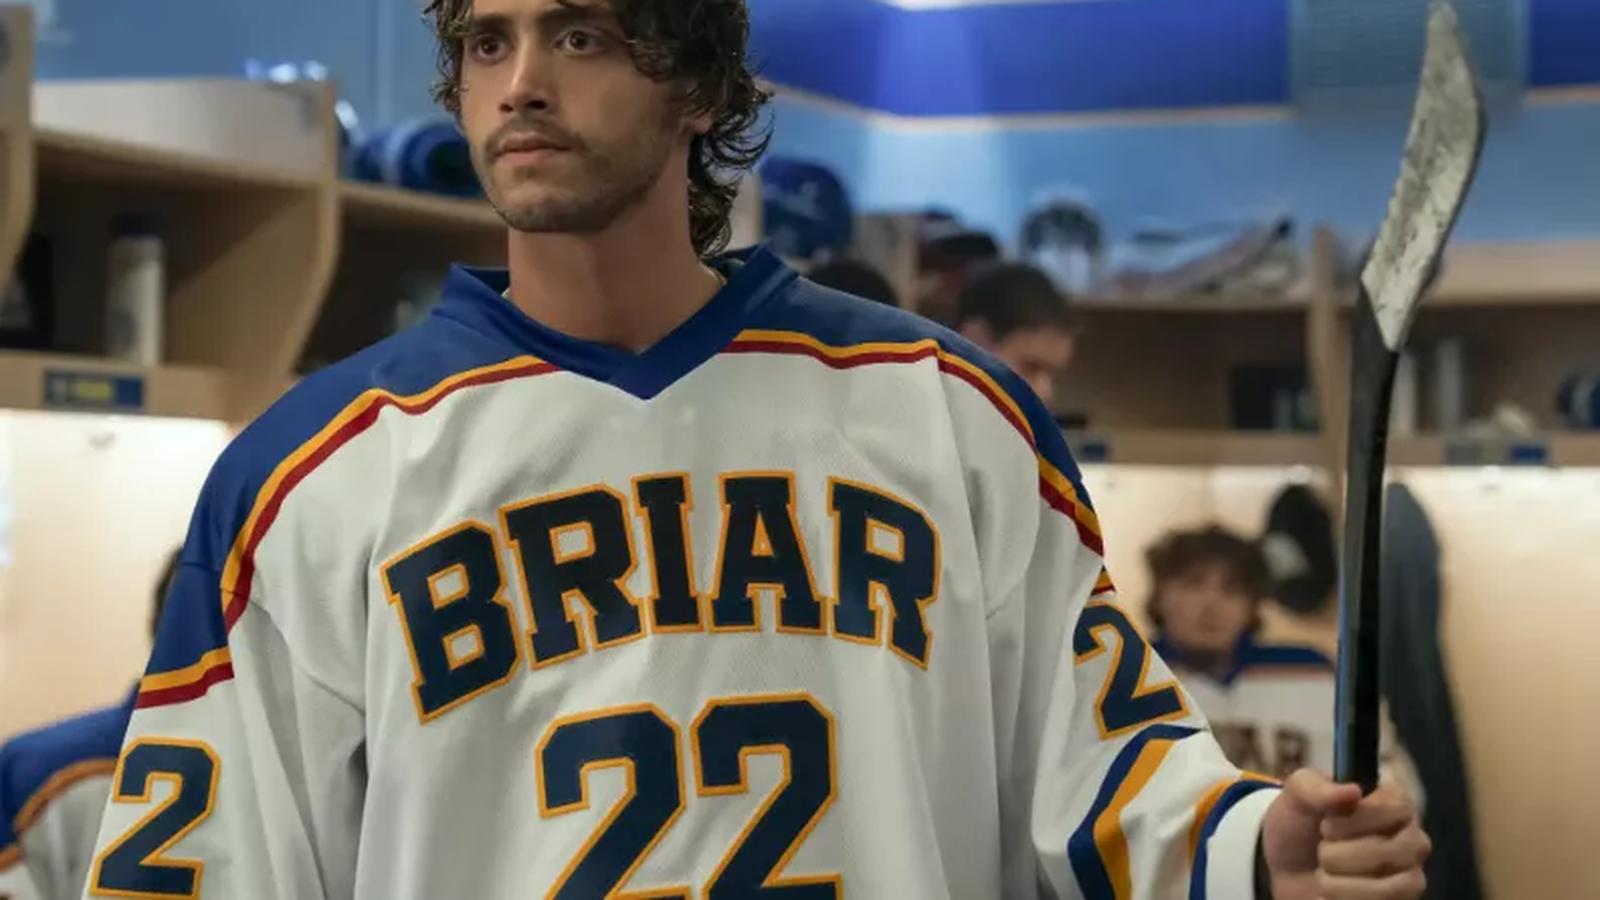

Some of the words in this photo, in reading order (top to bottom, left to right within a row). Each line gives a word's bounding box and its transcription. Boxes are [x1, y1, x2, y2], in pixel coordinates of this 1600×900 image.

[380, 470, 941, 725] BRIAR
[1072, 600, 1190, 741] 2
[89, 736, 221, 900] 2
[534, 692, 843, 900] 22
